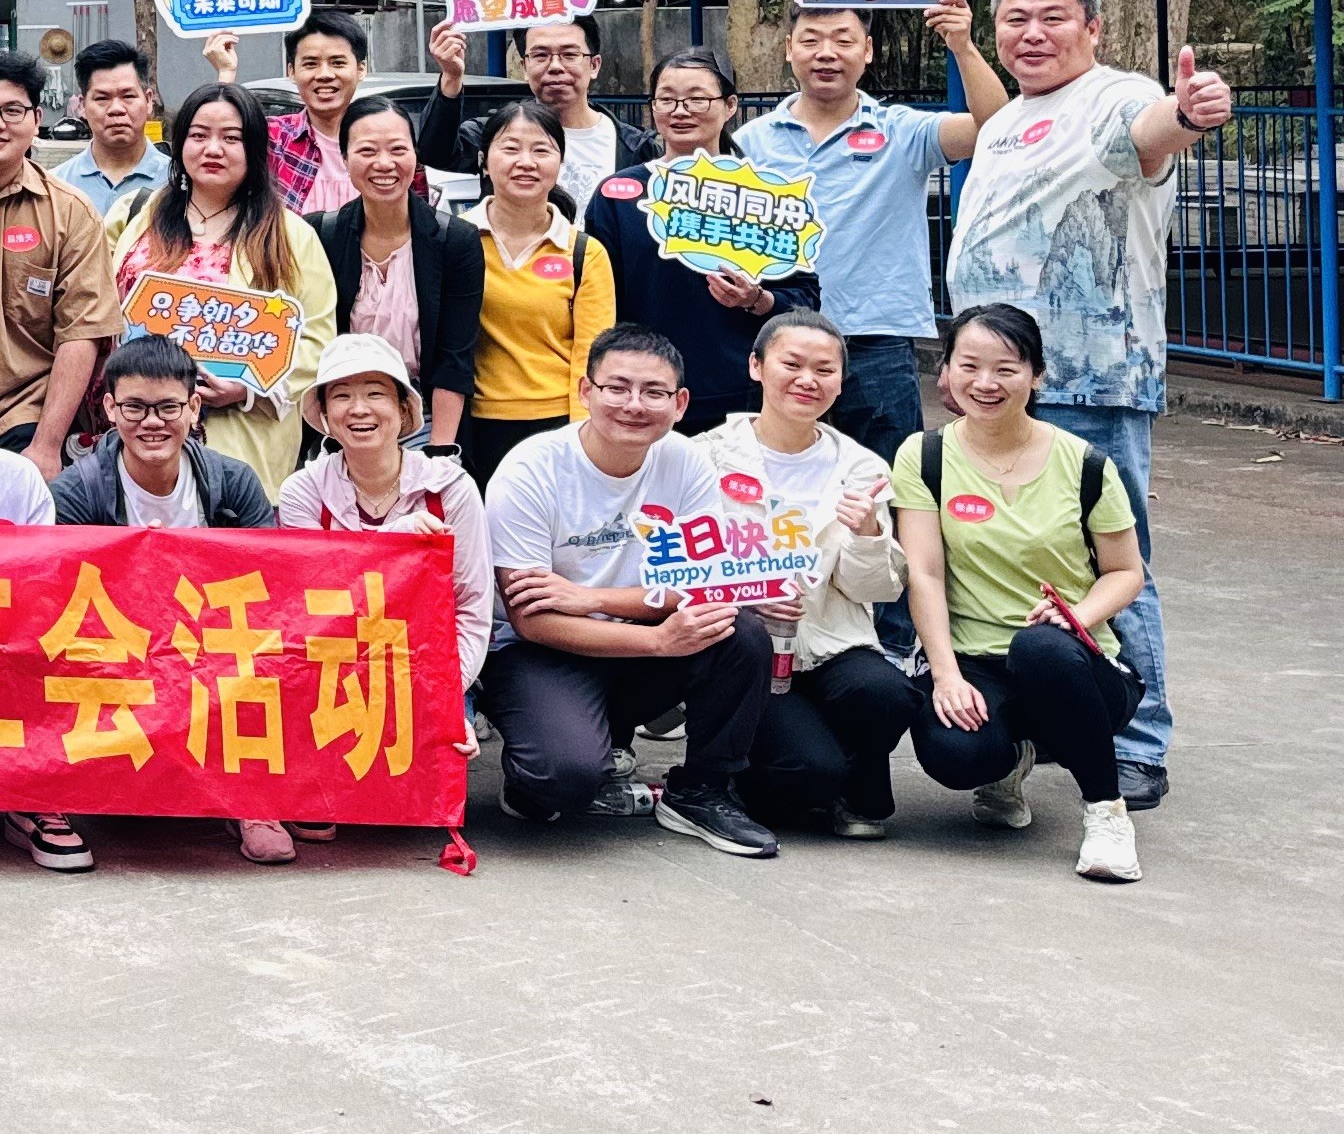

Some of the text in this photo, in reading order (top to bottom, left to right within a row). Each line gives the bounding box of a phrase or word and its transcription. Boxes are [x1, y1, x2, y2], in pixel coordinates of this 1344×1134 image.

[663, 170, 811, 231] 风雨同舟
[666, 207, 799, 262] 携手共进
[147, 291, 259, 328] 只争朝夕
[167, 323, 279, 359] 不负韶华
[646, 510, 811, 566] 生日快乐
[644, 552, 818, 587] Happy Birthday
[704, 580, 768, 602] to you!
